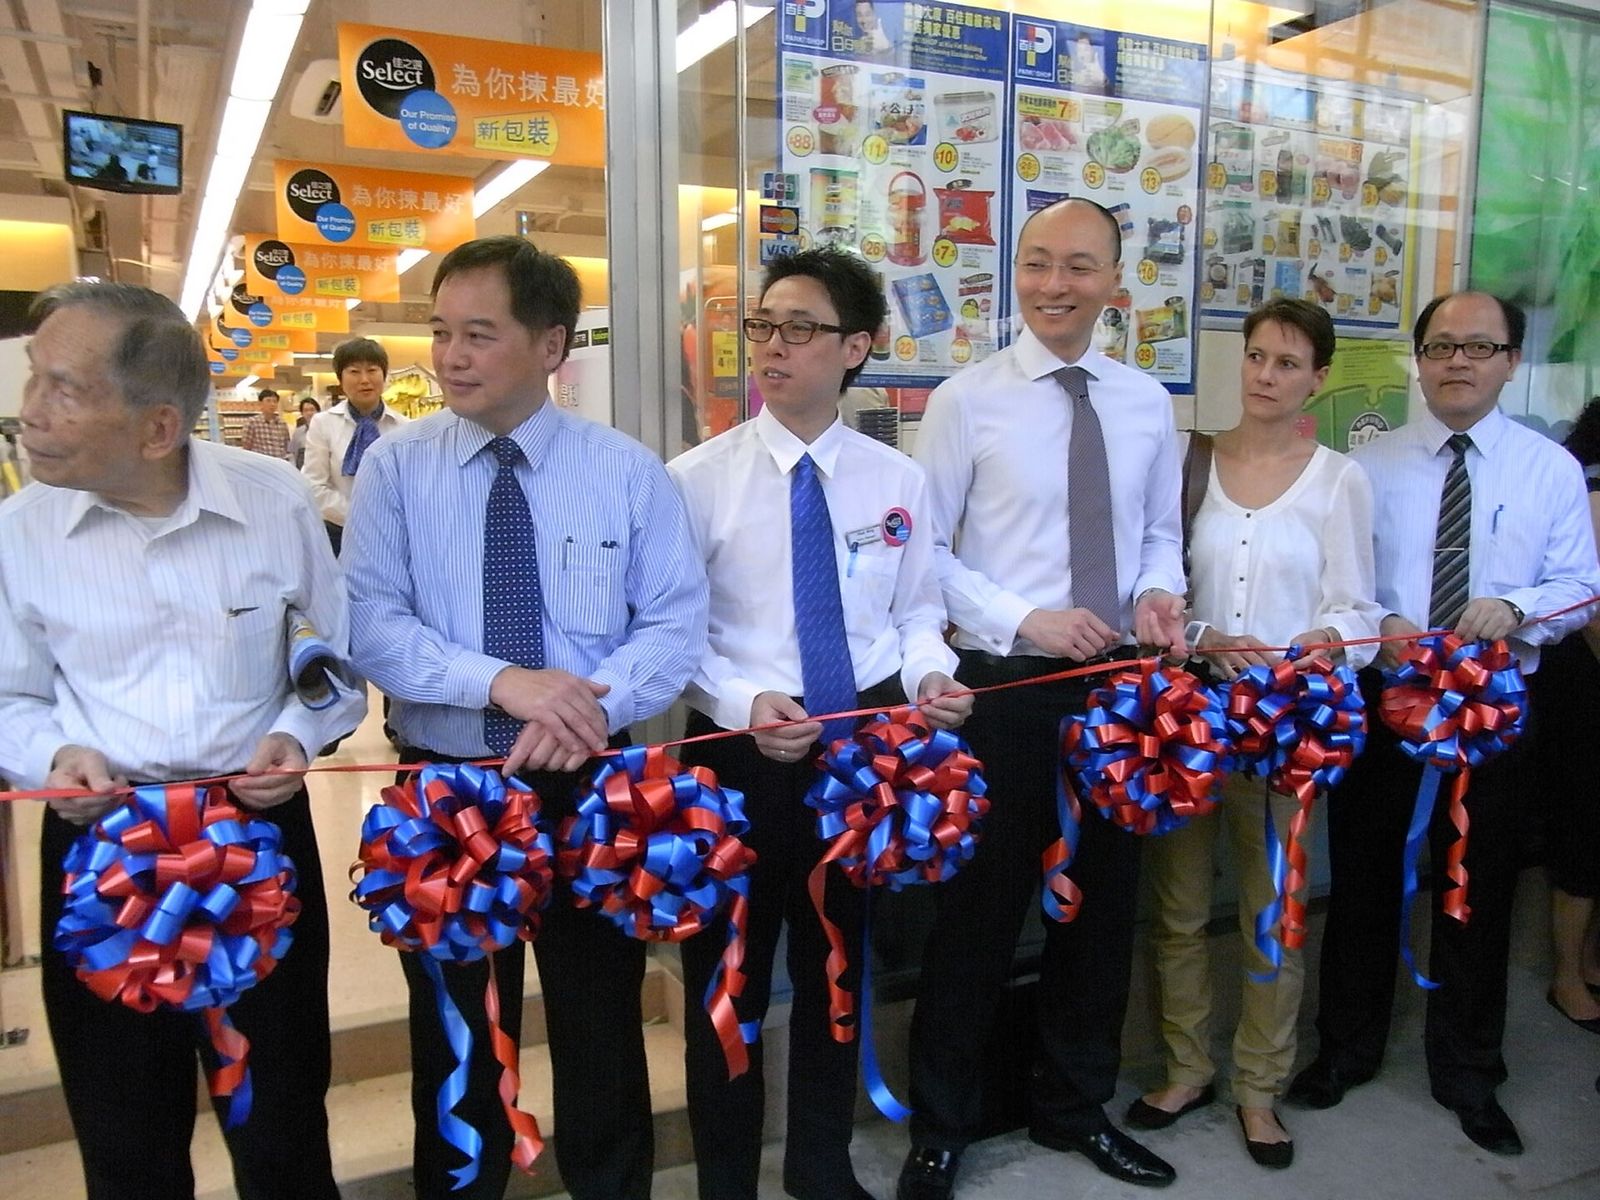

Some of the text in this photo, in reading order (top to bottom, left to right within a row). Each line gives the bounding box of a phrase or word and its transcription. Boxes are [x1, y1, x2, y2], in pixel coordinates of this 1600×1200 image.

[362, 60, 424, 85] Select
[400, 109, 418, 119] Our
[408, 122, 451, 134] of Quality
[477, 116, 550, 145] 新包裝
[290, 183, 333, 200] Select
[763, 182, 794, 192] JCB
[256, 250, 289, 263] Select
